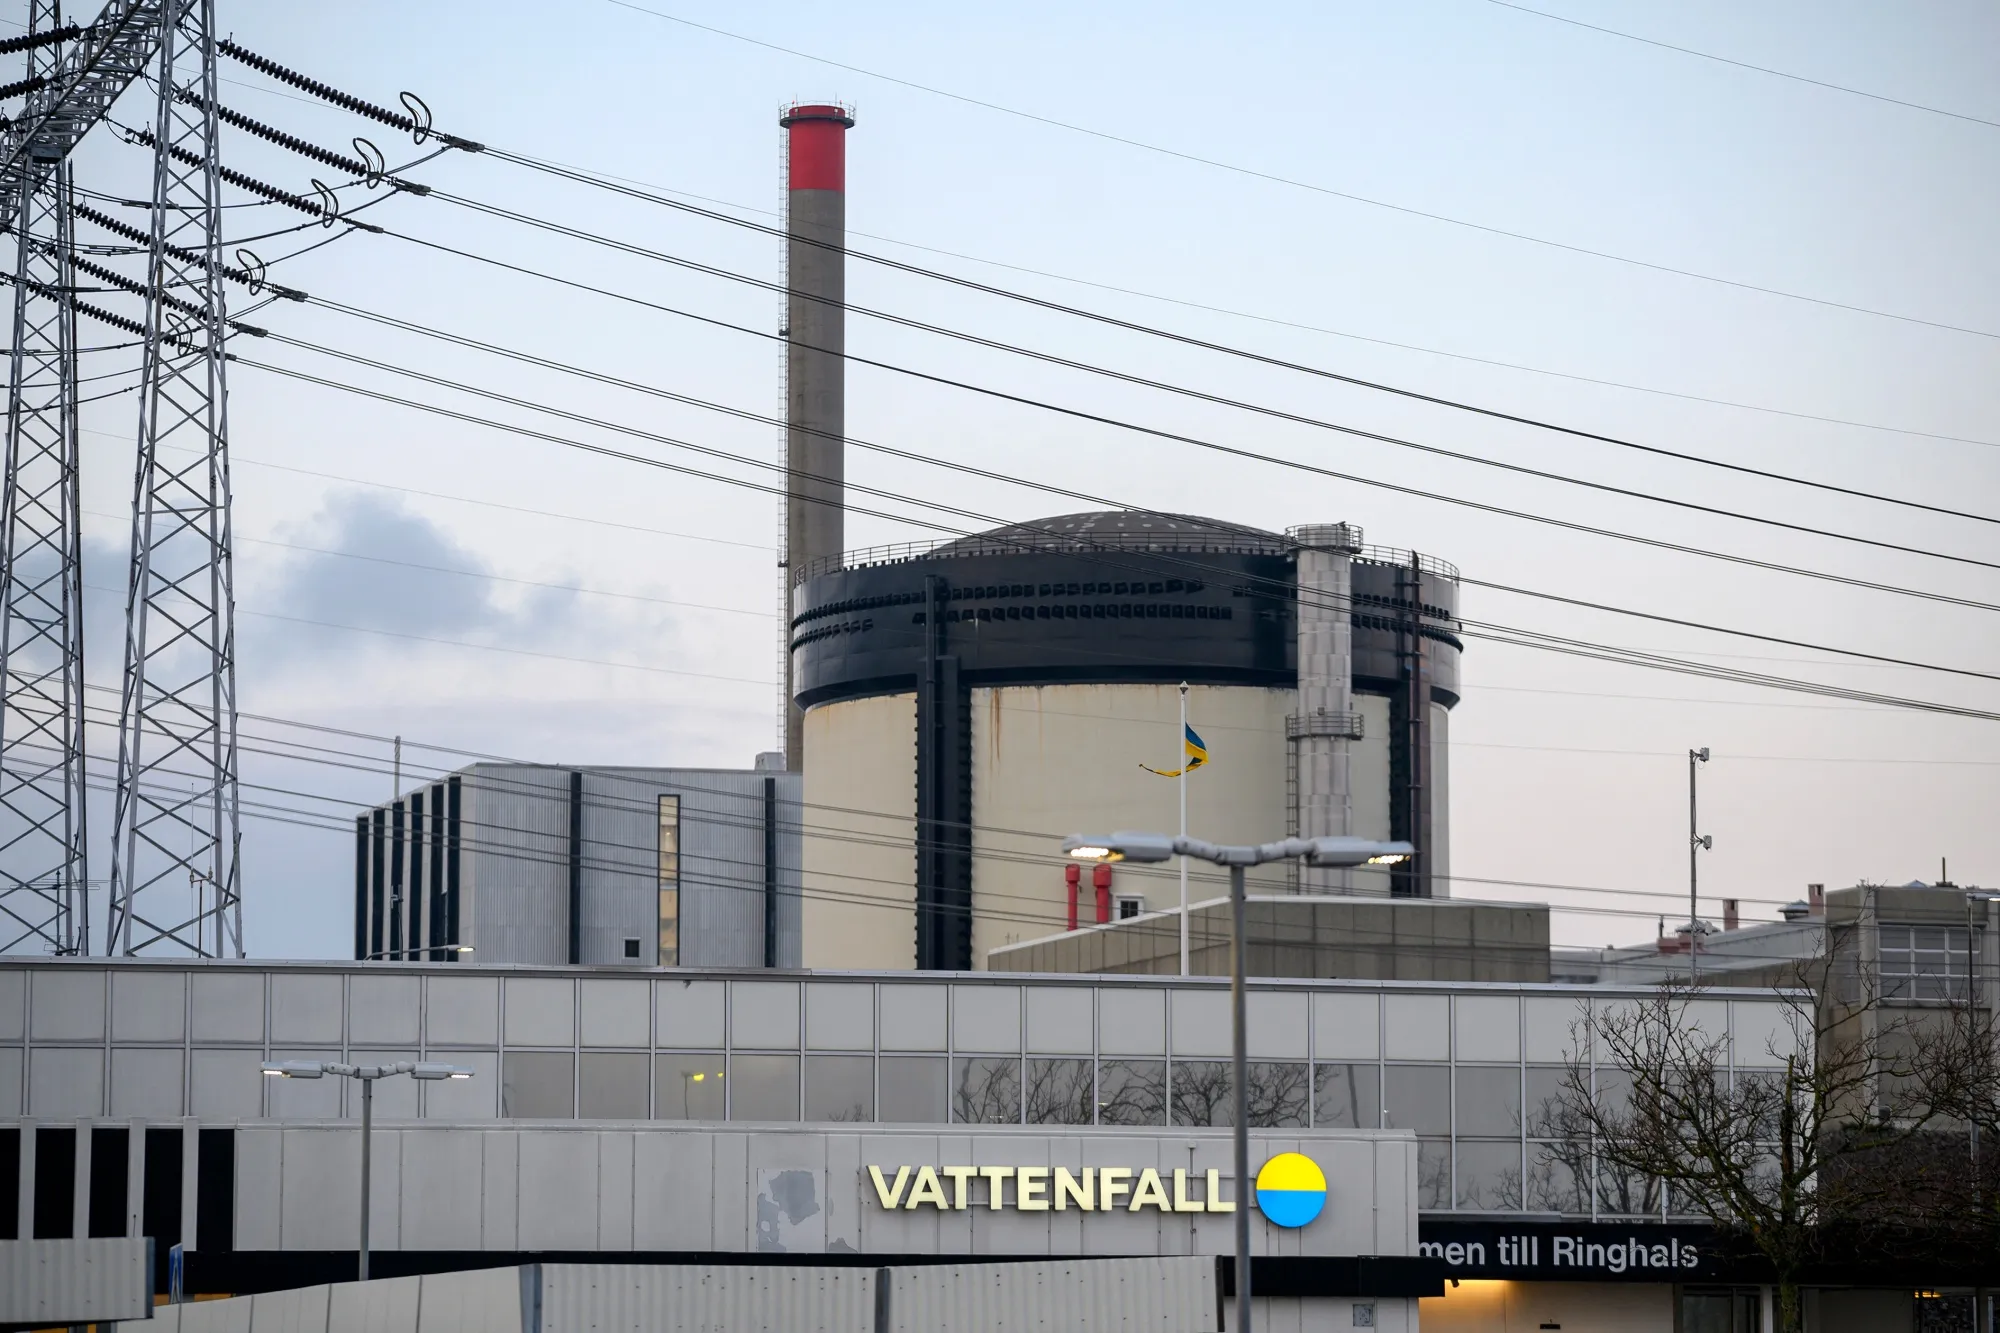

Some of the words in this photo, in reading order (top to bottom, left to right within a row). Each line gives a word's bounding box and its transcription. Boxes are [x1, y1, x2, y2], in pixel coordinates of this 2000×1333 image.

[867, 1165, 1236, 1212] VATTENFALL
[1497, 1236, 1538, 1265] till
[1553, 1236, 1698, 1273] Ringhals
